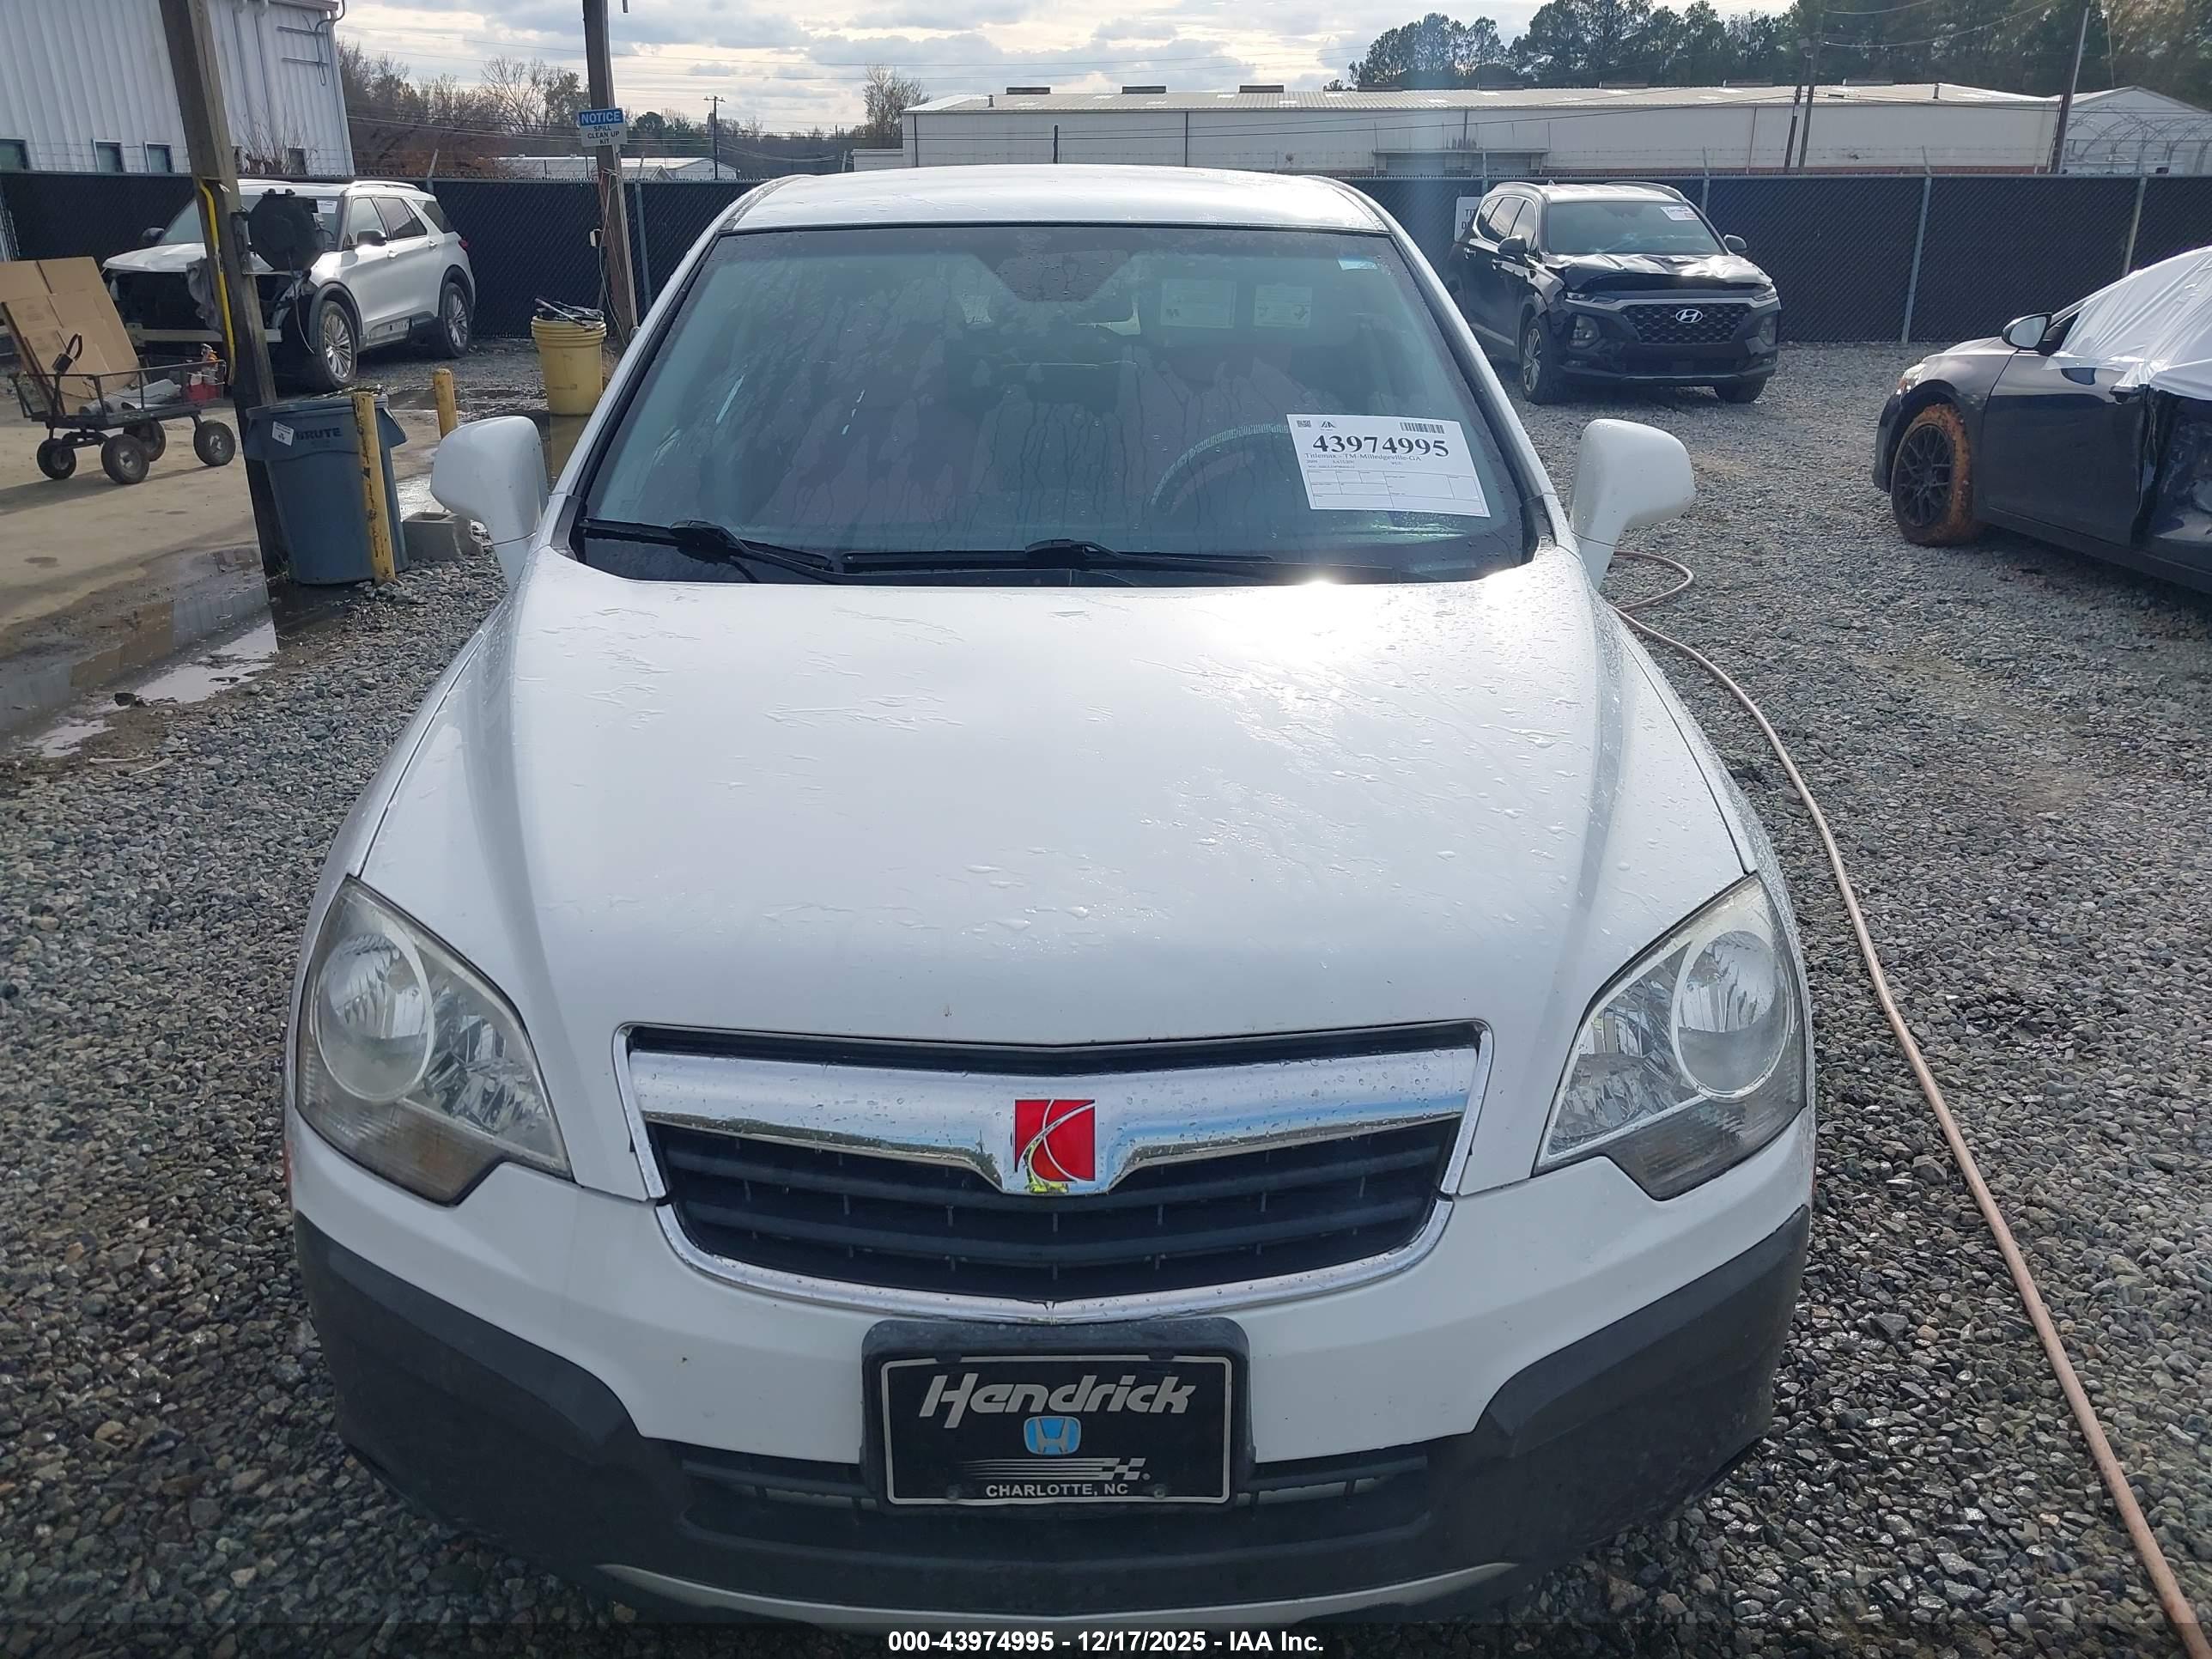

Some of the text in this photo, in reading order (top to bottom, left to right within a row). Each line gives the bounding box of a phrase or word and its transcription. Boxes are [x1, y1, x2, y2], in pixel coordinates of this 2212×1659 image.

[581, 112, 621, 124] NOTICE
[295, 427, 343, 441] BRUTE
[1312, 434, 1449, 458] 43974995
[919, 1373, 1196, 1428] Hendrick
[986, 1484, 1128, 1497] CHARLOTTE, NC
